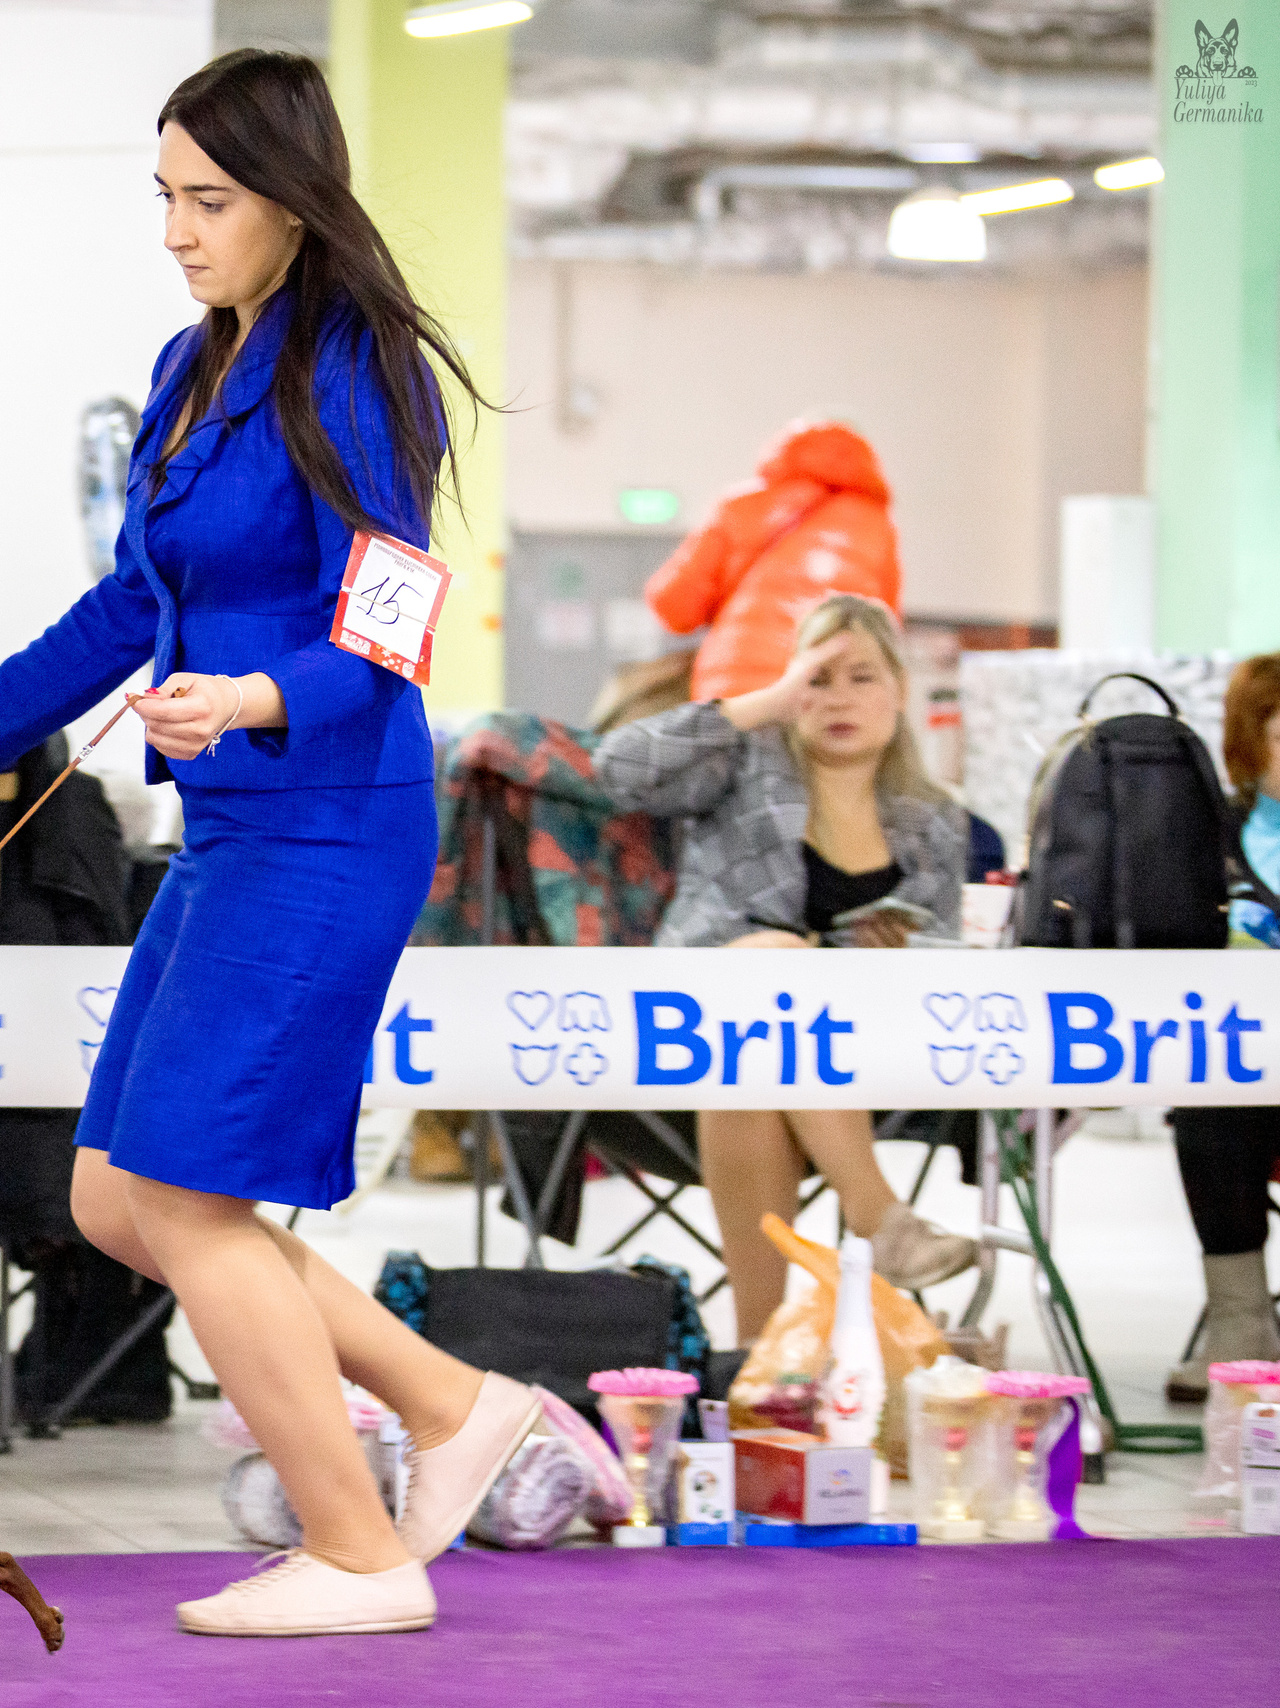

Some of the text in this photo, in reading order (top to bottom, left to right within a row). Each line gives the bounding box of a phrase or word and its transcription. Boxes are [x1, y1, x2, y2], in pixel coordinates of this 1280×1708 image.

[357, 575, 424, 625] 15
[631, 990, 856, 1086] Brit
[1045, 990, 1265, 1085] Brit
